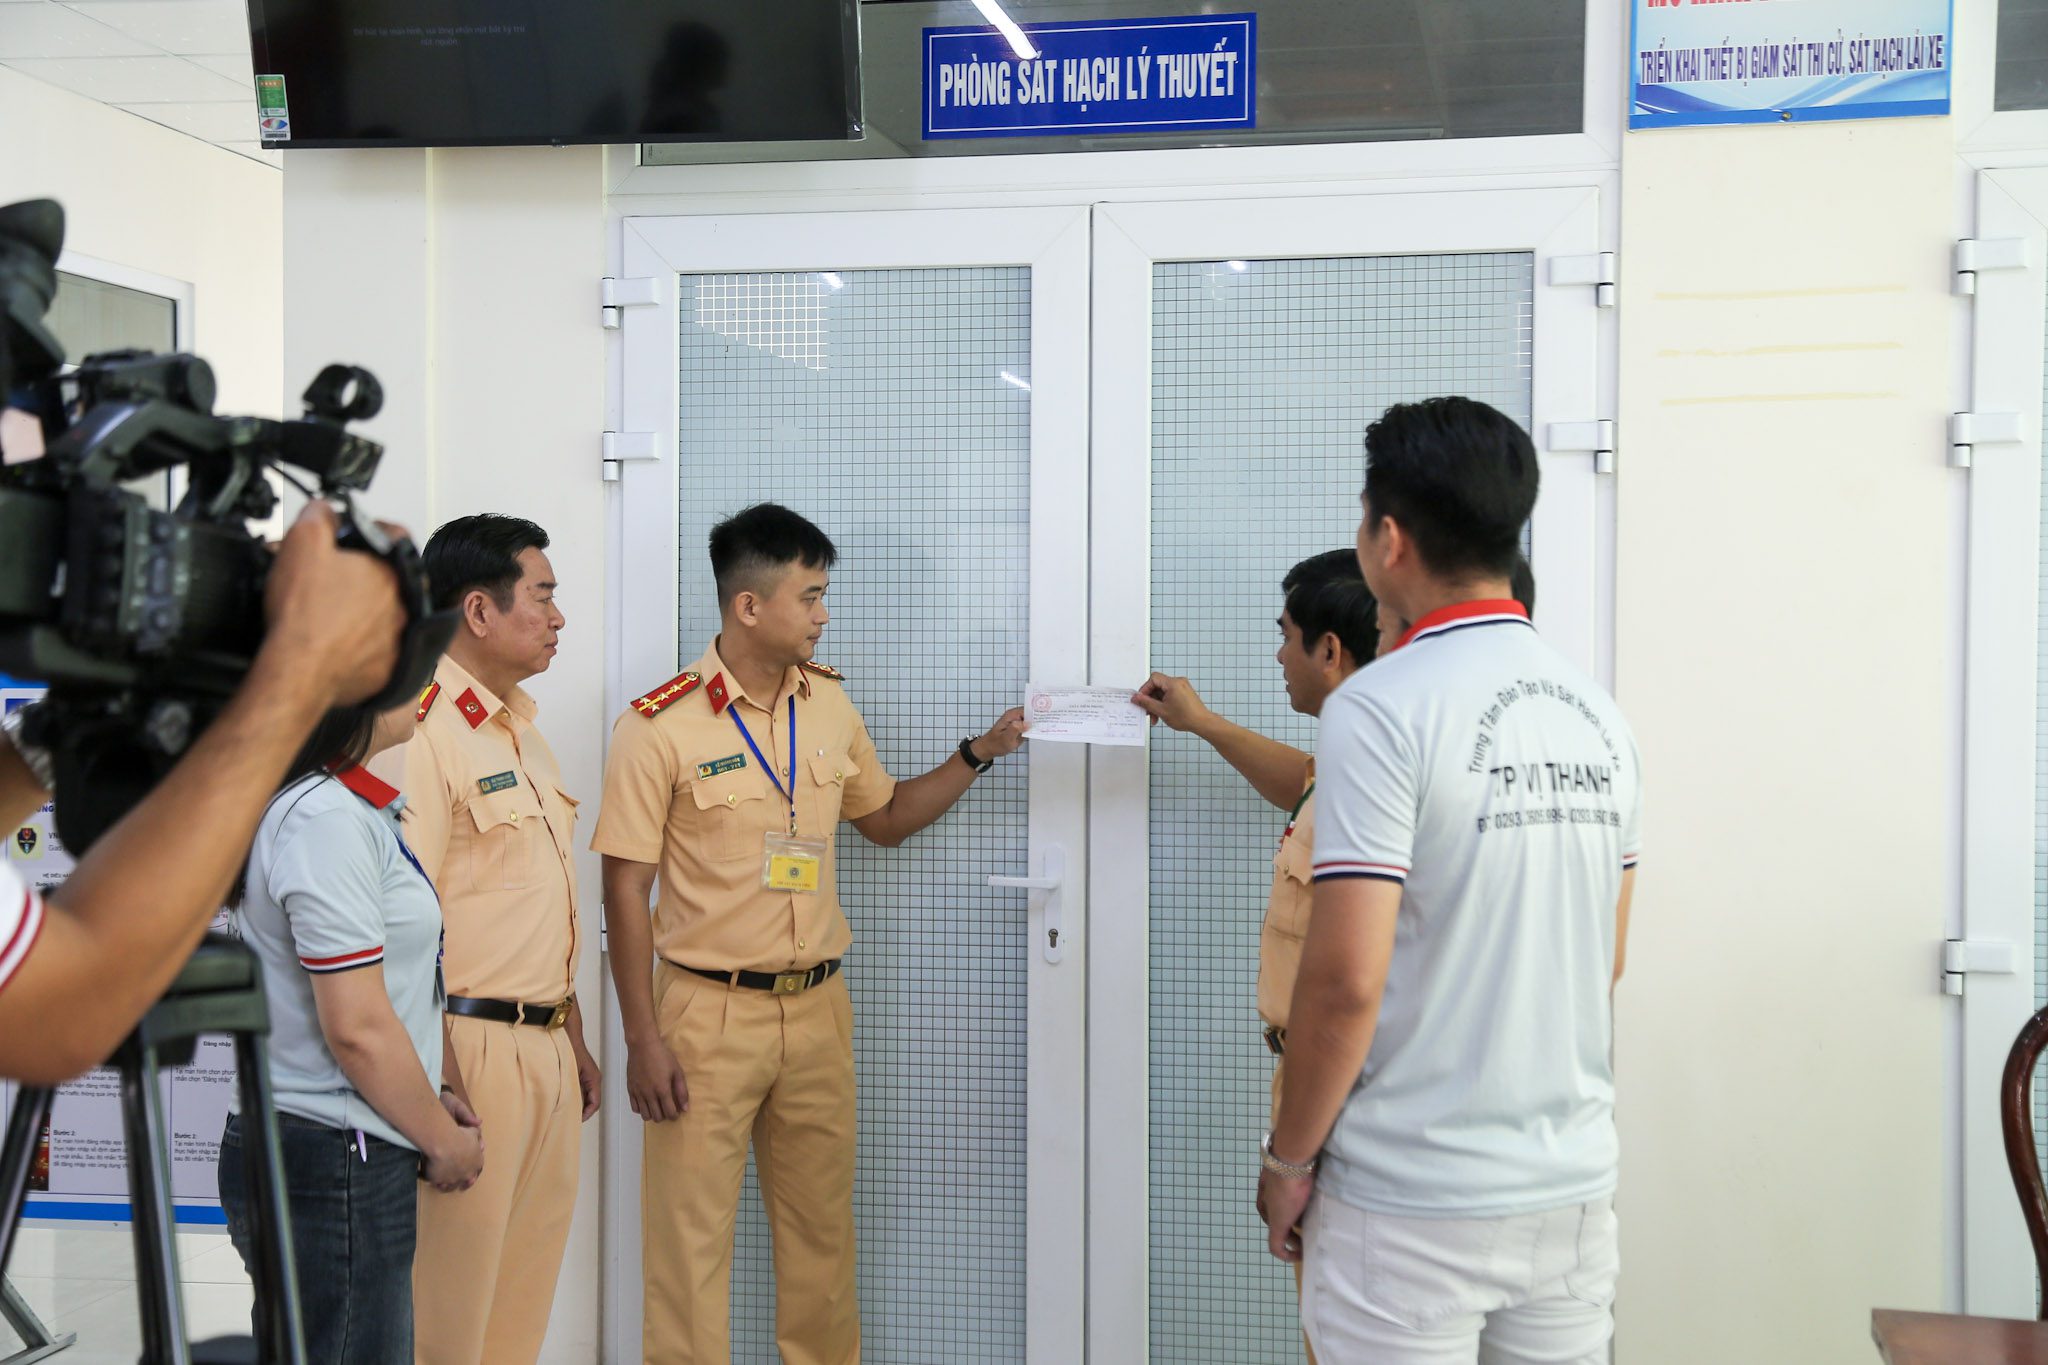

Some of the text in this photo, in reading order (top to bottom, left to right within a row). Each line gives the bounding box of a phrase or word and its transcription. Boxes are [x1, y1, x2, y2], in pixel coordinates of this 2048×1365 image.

[940, 37, 1237, 112] PHÒNG SÁT HẠCH LÝ THUYẾT
[1640, 37, 1672, 84] TRIỂN
[1675, 48, 1701, 82] KHAI
[1704, 35, 1734, 81] THIẾT
[1737, 46, 1748, 87] BỊ
[1751, 38, 1780, 79] GIÁM
[1783, 36, 1804, 77] SÁT
[1807, 42, 1824, 76] THI
[1849, 32, 1871, 74] SÁT
[1873, 37, 1904, 79] HẠCH
[1907, 28, 1925, 70] LÁI
[1928, 34, 1944, 68] XE
[1516, 680, 1539, 699] Tạo
[1479, 704, 1503, 730] Tâm
[1468, 732, 1492, 774] Trung
[1490, 763, 1611, 801] TP VỊ THANH
